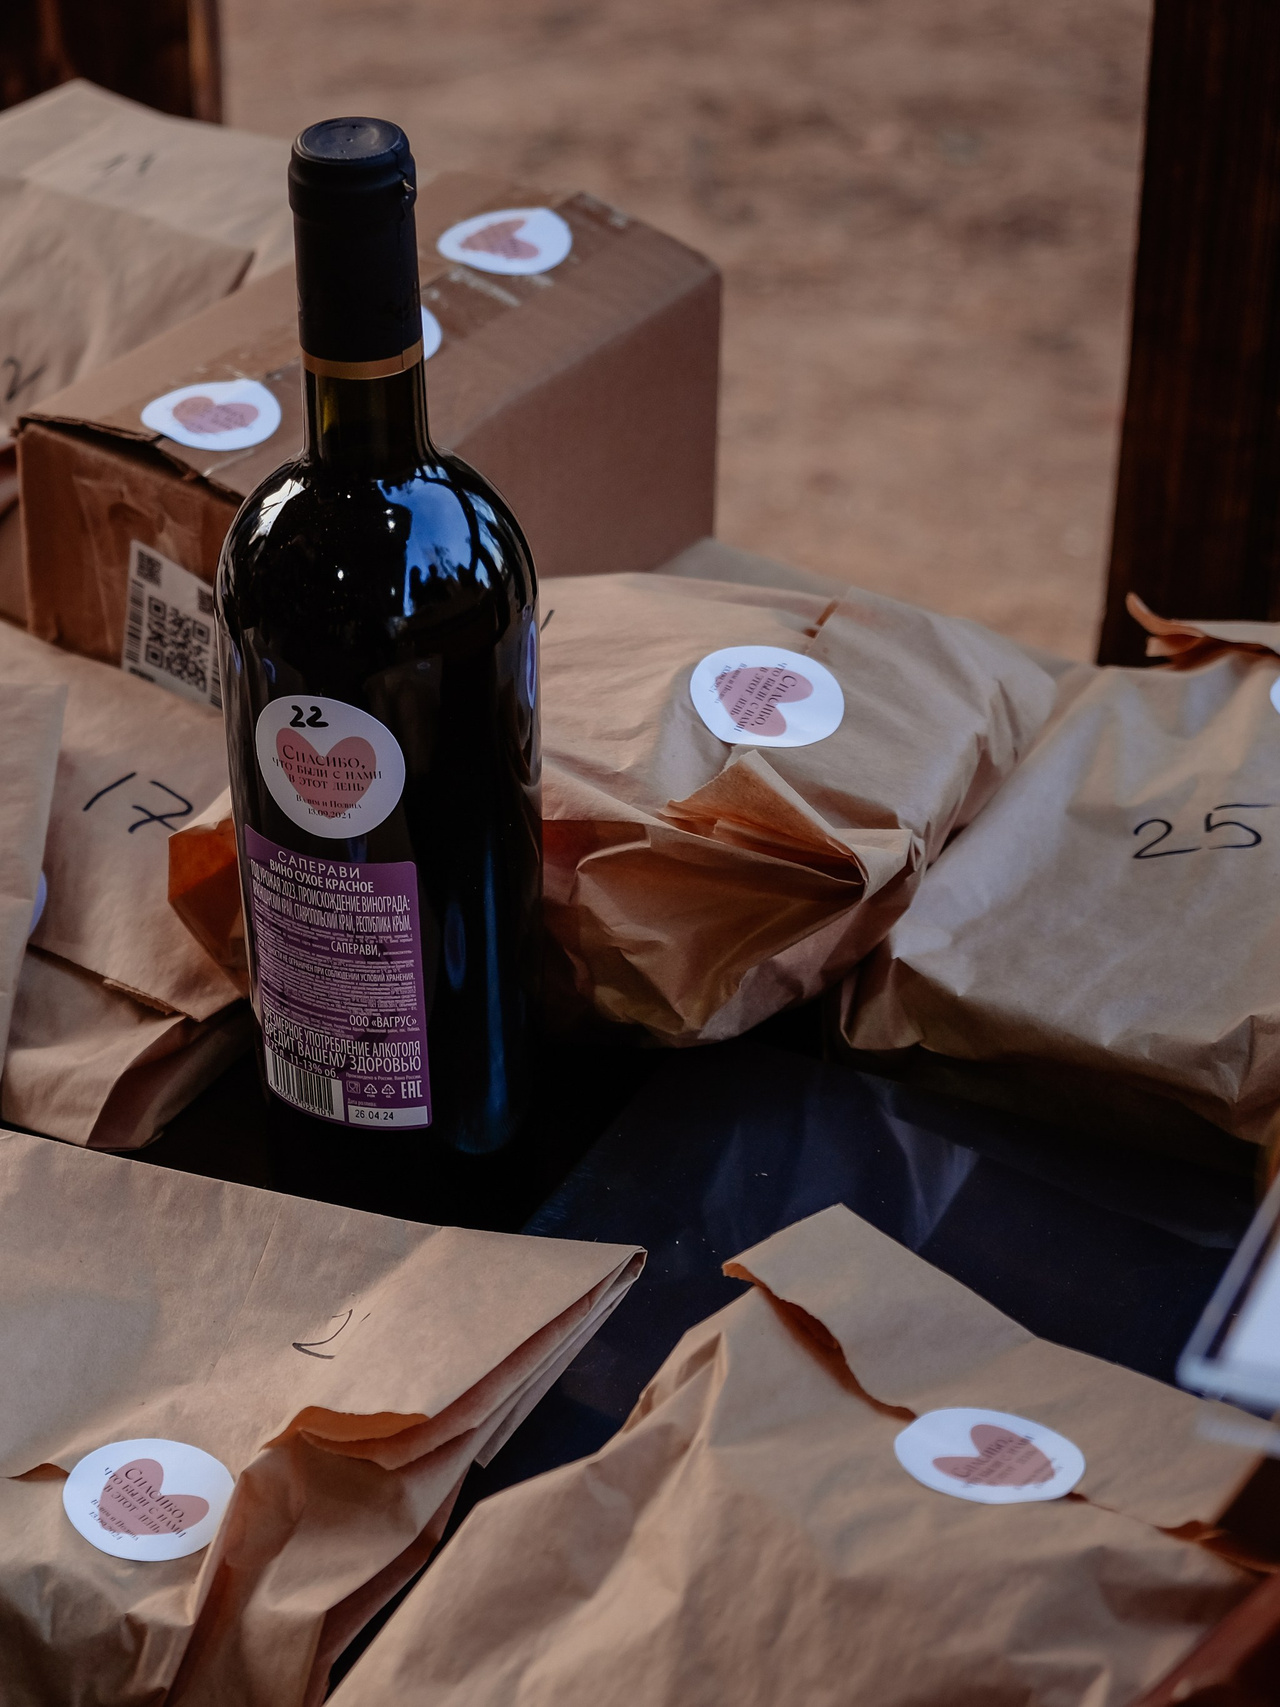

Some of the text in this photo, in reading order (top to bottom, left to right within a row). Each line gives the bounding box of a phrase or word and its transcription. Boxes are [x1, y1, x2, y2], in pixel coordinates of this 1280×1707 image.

[289, 704, 329, 728] 22
[82, 771, 194, 834] 17
[1132, 803, 1276, 860] 25
[269, 858, 374, 893] ВИНО СУХОЕ КРАСНОЕ
[277, 850, 360, 880] САПЕРАВИ
[298, 885, 361, 913] ПРОИСХОЖДЕНИЕ
[361, 894, 411, 915] ВИНОГРАДА:
[330, 940, 381, 957] САПЕРАВИ,
[264, 1020, 421, 1074] ВРЕДИТ ВАШЕМУ ЗДОРОВЬЮ
[305, 1029, 370, 1057] УПОТРЕБЛЕНИЕ
[372, 1040, 421, 1058] АЛКОГОЛЯ
